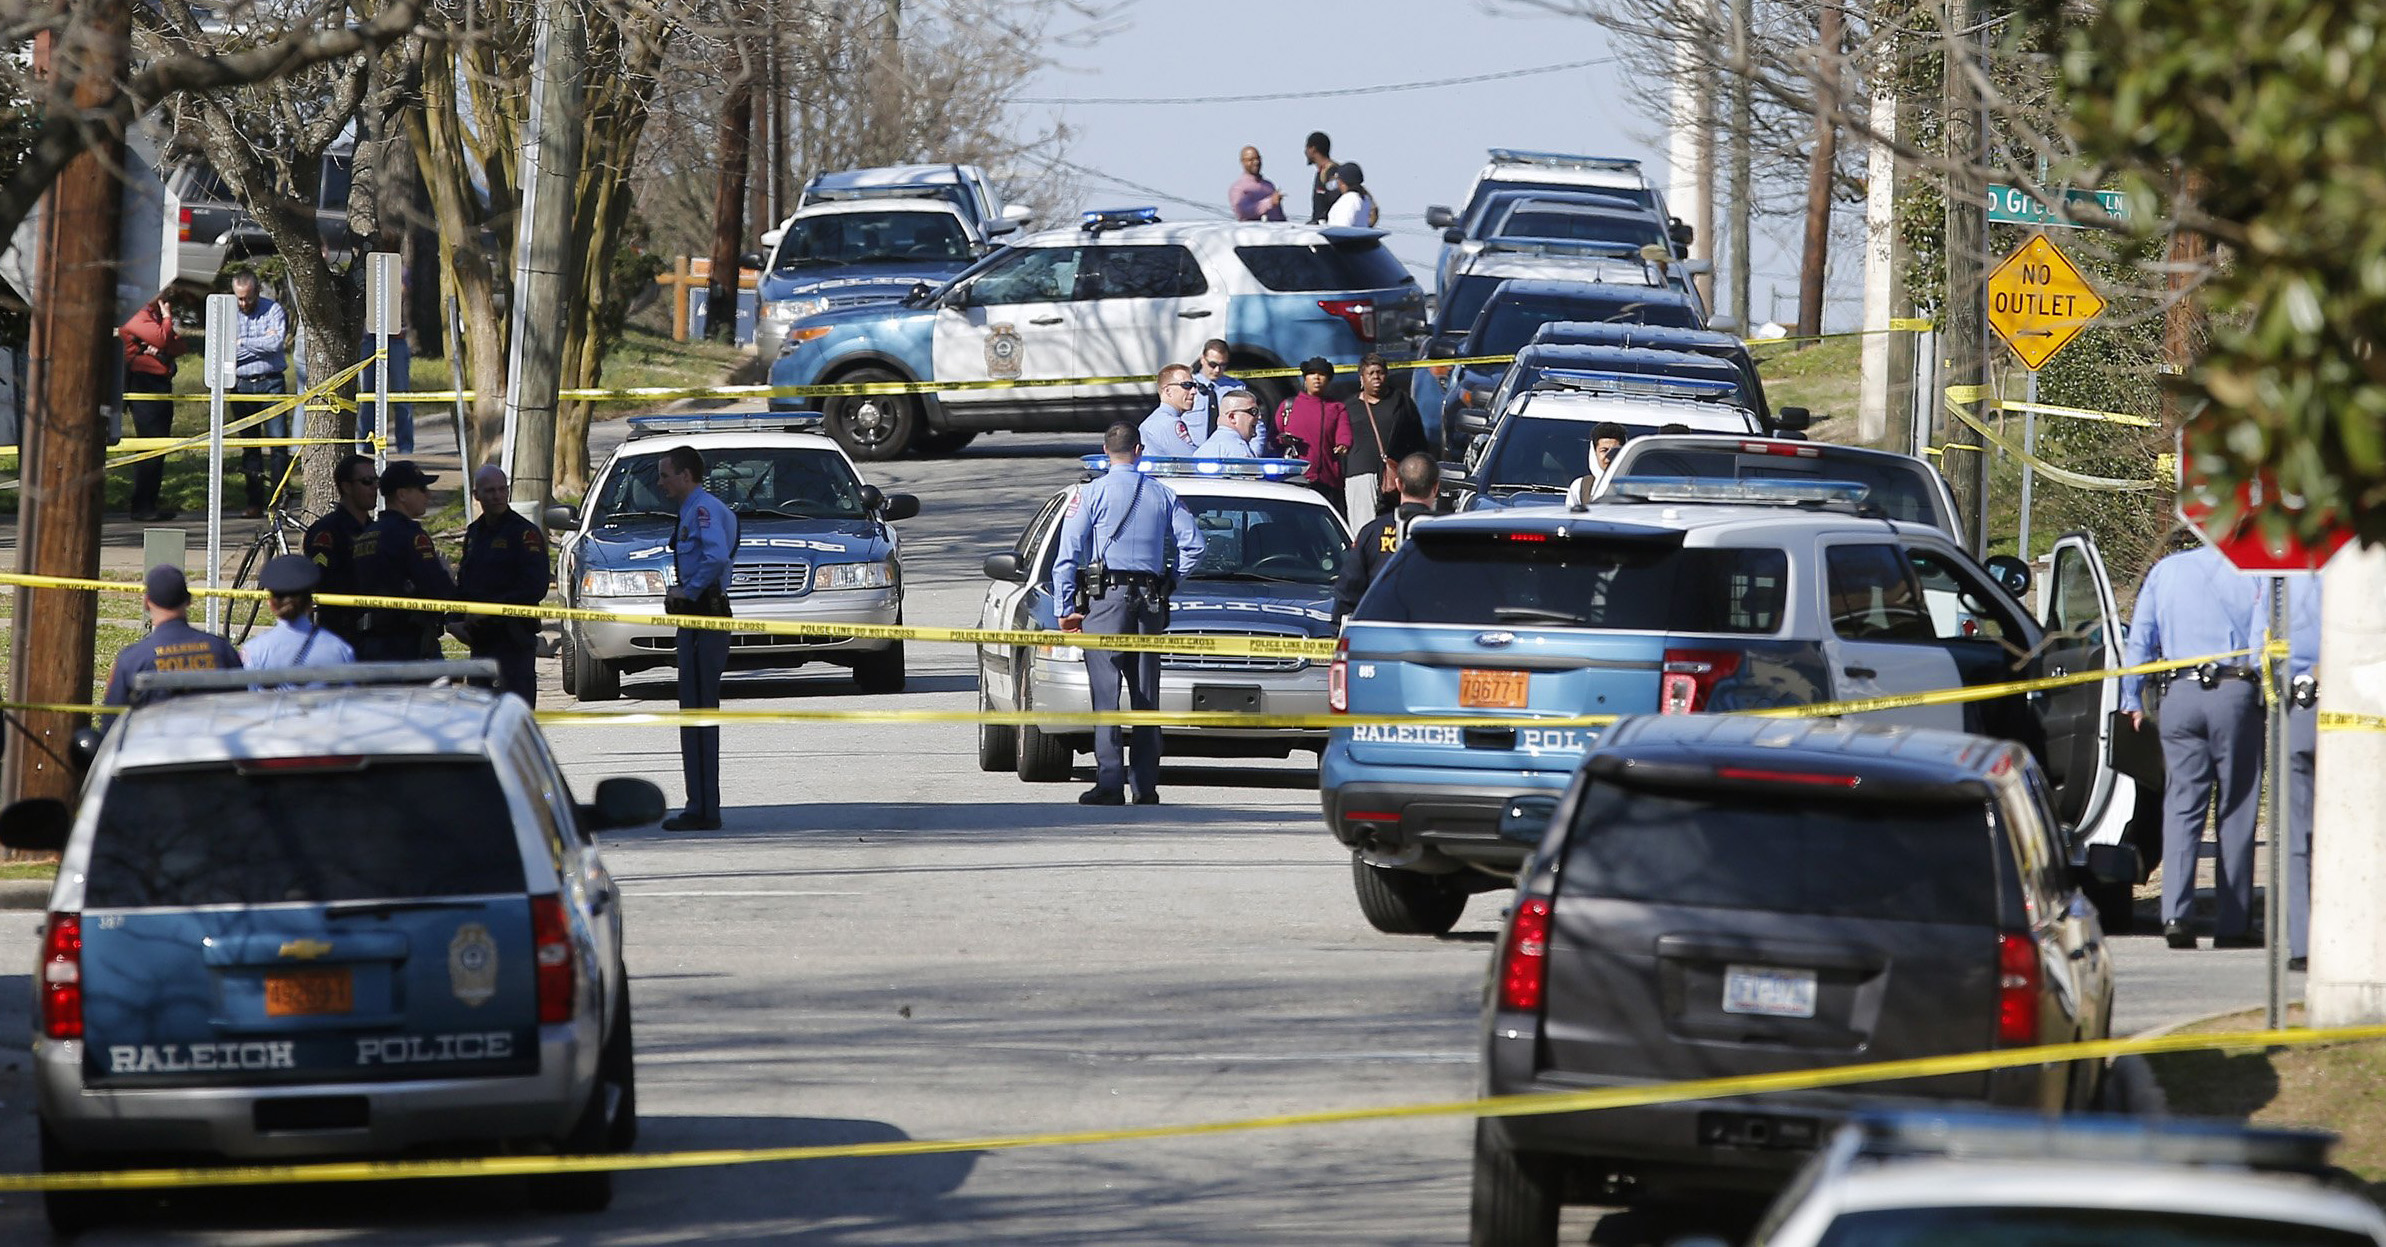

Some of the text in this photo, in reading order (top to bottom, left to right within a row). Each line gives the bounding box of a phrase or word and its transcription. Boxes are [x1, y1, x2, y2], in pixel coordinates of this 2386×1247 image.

[2105, 195, 2123, 210] LN
[2022, 264, 2051, 285] NO
[1995, 292, 2076, 317] OUTLET
[628, 538, 846, 561] PICE
[204, 591, 236, 599] POLICE
[239, 592, 256, 600] LINE
[353, 598, 468, 613] POLICE LINE DO NOT CROSS
[1169, 600, 1333, 622] LICE
[502, 607, 617, 622] POLICE LINE DO NOT CROSS
[650, 617, 767, 631] POLICE LINE DO NOT CROSS
[800, 624, 916, 638] POLICE LINE DO NOT CROSS
[949, 630, 1065, 643] POLICE LINE DO NOT CROSS
[1099, 635, 1129, 644] POLICE
[1132, 636, 1150, 644] LINE
[1154, 637, 1165, 645] DO
[1187, 638, 1215, 646] CROSS
[1250, 639, 1279, 648] POLICE
[1318, 642, 1334, 650] NOT
[155, 653, 215, 672] POLICE
[1462, 679, 1524, 701] 79677-T
[1352, 723, 1461, 745] RALEIGH
[109, 1032, 512, 1074] RALEIGH POLICE
